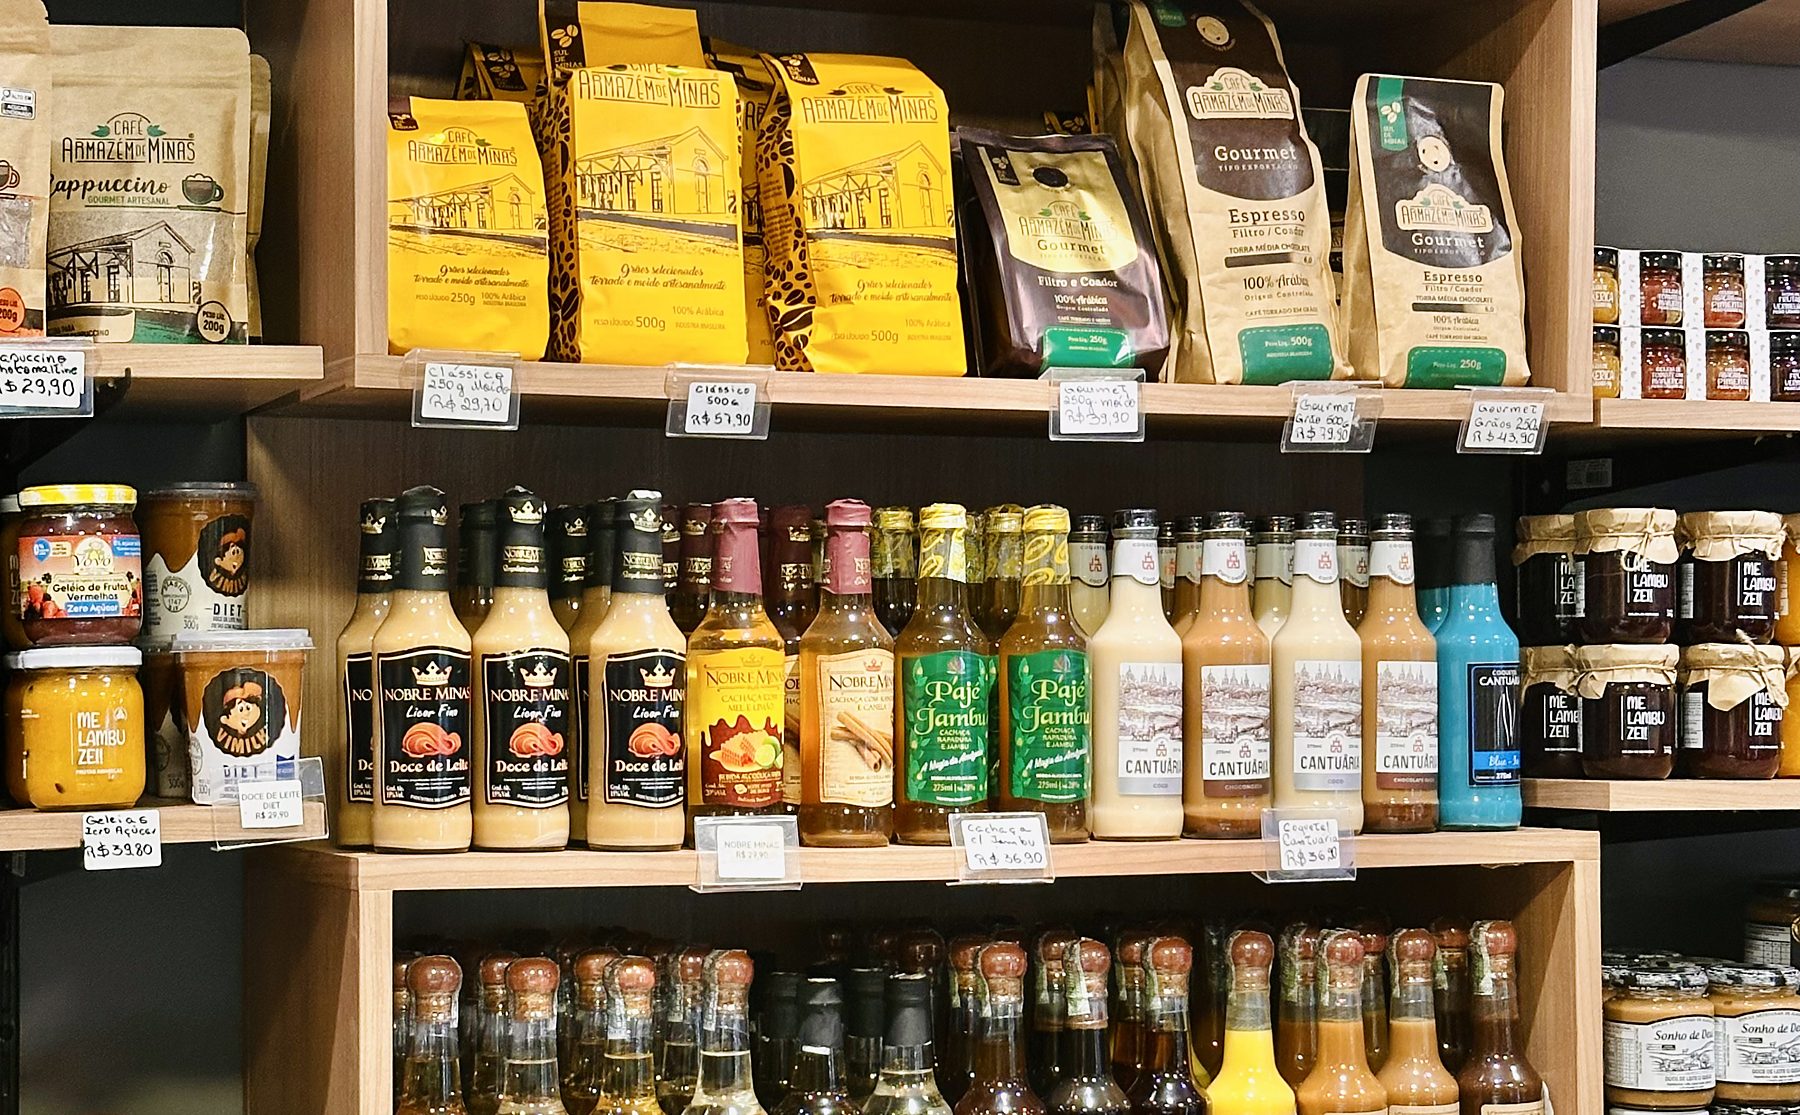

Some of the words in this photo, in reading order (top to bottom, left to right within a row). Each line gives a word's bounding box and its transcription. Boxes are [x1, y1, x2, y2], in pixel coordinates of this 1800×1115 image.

[578, 70, 656, 101] ARMAZÉM
[668, 78, 721, 108] MINAS
[847, 84, 880, 94] CAFÉ
[1224, 77, 1246, 90] CAFÉ
[802, 95, 878, 124] ARMAZÉM
[889, 96, 938, 124] MINAS
[1192, 92, 1245, 114] ARMAZÉM
[1254, 93, 1290, 115] MINAS
[114, 117, 144, 136] CAFÉ
[448, 130, 474, 143] CAFÉ
[62, 136, 135, 163] ARMAZÉM
[147, 138, 196, 163] MINAS
[408, 140, 467, 163] ARMAZÉM
[477, 146, 518, 166] MINAS
[1214, 145, 1298, 162] Gourmet
[88, 195, 124, 205] GOURMET
[126, 196, 170, 206] ARTESANAL
[1052, 203, 1077, 218] CAFÉ
[1228, 208, 1305, 226] Espresso
[1401, 205, 1449, 225] ARMAZÉM
[1454, 208, 1487, 227] MINAS
[1019, 215, 1073, 238] ARMAZÉM
[1232, 229, 1265, 239] Filtro
[1411, 232, 1485, 249] Gourmet
[1037, 239, 1106, 255] Gourmet
[1229, 246, 1254, 254] TORRA
[1255, 243, 1279, 252] MÉDIA
[1037, 275, 1068, 288] Filtro
[1070, 279, 1078, 288] e
[1080, 276, 1118, 289] Coador
[1243, 275, 1274, 290] 100%
[1424, 270, 1483, 284] Espresso
[481, 291, 500, 301] 100%
[501, 291, 527, 301] Arábica
[1425, 285, 1448, 293] Filtro
[450, 293, 476, 305] 250g
[1054, 294, 1076, 304] 100%
[1244, 292, 1273, 302] Origem
[1437, 295, 1458, 303] MÉDIA
[672, 305, 694, 315] 100%
[696, 305, 725, 317] Arábica
[203, 320, 225, 335] 200g
[635, 316, 666, 332] 500g
[871, 330, 899, 344] 500g
[1290, 336, 1313, 348] 500g
[1459, 359, 1482, 371] 250g
[428, 366, 504, 380] Clássico
[21, 378, 75, 397] 29,90
[428, 379, 465, 398] 250g
[695, 385, 750, 395] Clássico
[429, 393, 457, 413] R$
[461, 397, 502, 414] 29,70
[1478, 404, 1537, 414] Gourmet
[691, 410, 711, 426] R$
[1474, 417, 1512, 430] Grãos
[1296, 425, 1316, 442] R$
[1472, 431, 1494, 444] R$
[1743, 562, 1762, 576] ME
[88, 583, 101, 591] de
[1633, 573, 1669, 588] LAMBU
[1743, 577, 1777, 592] LAMBU
[66, 592, 118, 601] Vermelhas
[66, 604, 88, 613] Zero
[89, 603, 118, 614] Açúcar
[213, 602, 242, 617] DIET
[706, 670, 755, 687] NOBRE
[829, 674, 878, 692] NOBRE
[385, 687, 431, 701] NOBRE
[490, 689, 539, 702] NOBRE
[610, 688, 658, 702] NOBRE
[925, 675, 981, 709] Pajé
[1031, 675, 1086, 707] Pajé
[721, 694, 762, 703] CACHAÇA
[829, 696, 864, 705] CACHAÇA
[1549, 695, 1568, 709] ME
[1627, 695, 1647, 710] ME
[406, 704, 435, 718] Licor
[728, 704, 744, 712] MEL
[1020, 696, 1090, 733] Jambu
[1755, 706, 1783, 721] LAMBU
[77, 711, 101, 729] ME
[914, 697, 987, 736] Jambu
[1627, 711, 1666, 726] LAMBU
[78, 729, 126, 747] LAMBU
[939, 729, 971, 737] CACHAÇA
[1044, 727, 1076, 735] CACHAÇA
[216, 727, 267, 754] VIMILK
[936, 736, 973, 744] RAPADURA
[946, 743, 970, 751] JAMBU
[1051, 741, 1075, 749] JAMBU
[390, 760, 425, 773] Doce
[426, 760, 444, 773] de
[496, 760, 531, 773] Doce
[532, 759, 549, 773] de
[615, 759, 651, 773] Doce
[652, 759, 667, 773] de
[1209, 758, 1269, 776] CANTUÁRIA
[932, 783, 953, 792] 275ml
[241, 792, 265, 801] DOCE
[266, 792, 277, 800] DE
[279, 790, 300, 799] LEITE
[262, 801, 280, 810] DIET
[255, 811, 266, 820] R$
[268, 811, 289, 820] 29,90
[967, 824, 1032, 836] Cachaça
[1283, 821, 1329, 836] Coquetel
[84, 842, 110, 858] R$
[724, 840, 752, 849] NOBRE
[754, 840, 780, 849] MINAS
[735, 850, 746, 859] R$
[974, 852, 1000, 866] R$
[1286, 849, 1307, 867] R$
[1654, 1030, 1687, 1041] Sonho
[1689, 1029, 1700, 1041] de
[1741, 1023, 1775, 1034] Sonho
[1777, 1023, 1789, 1034] de
